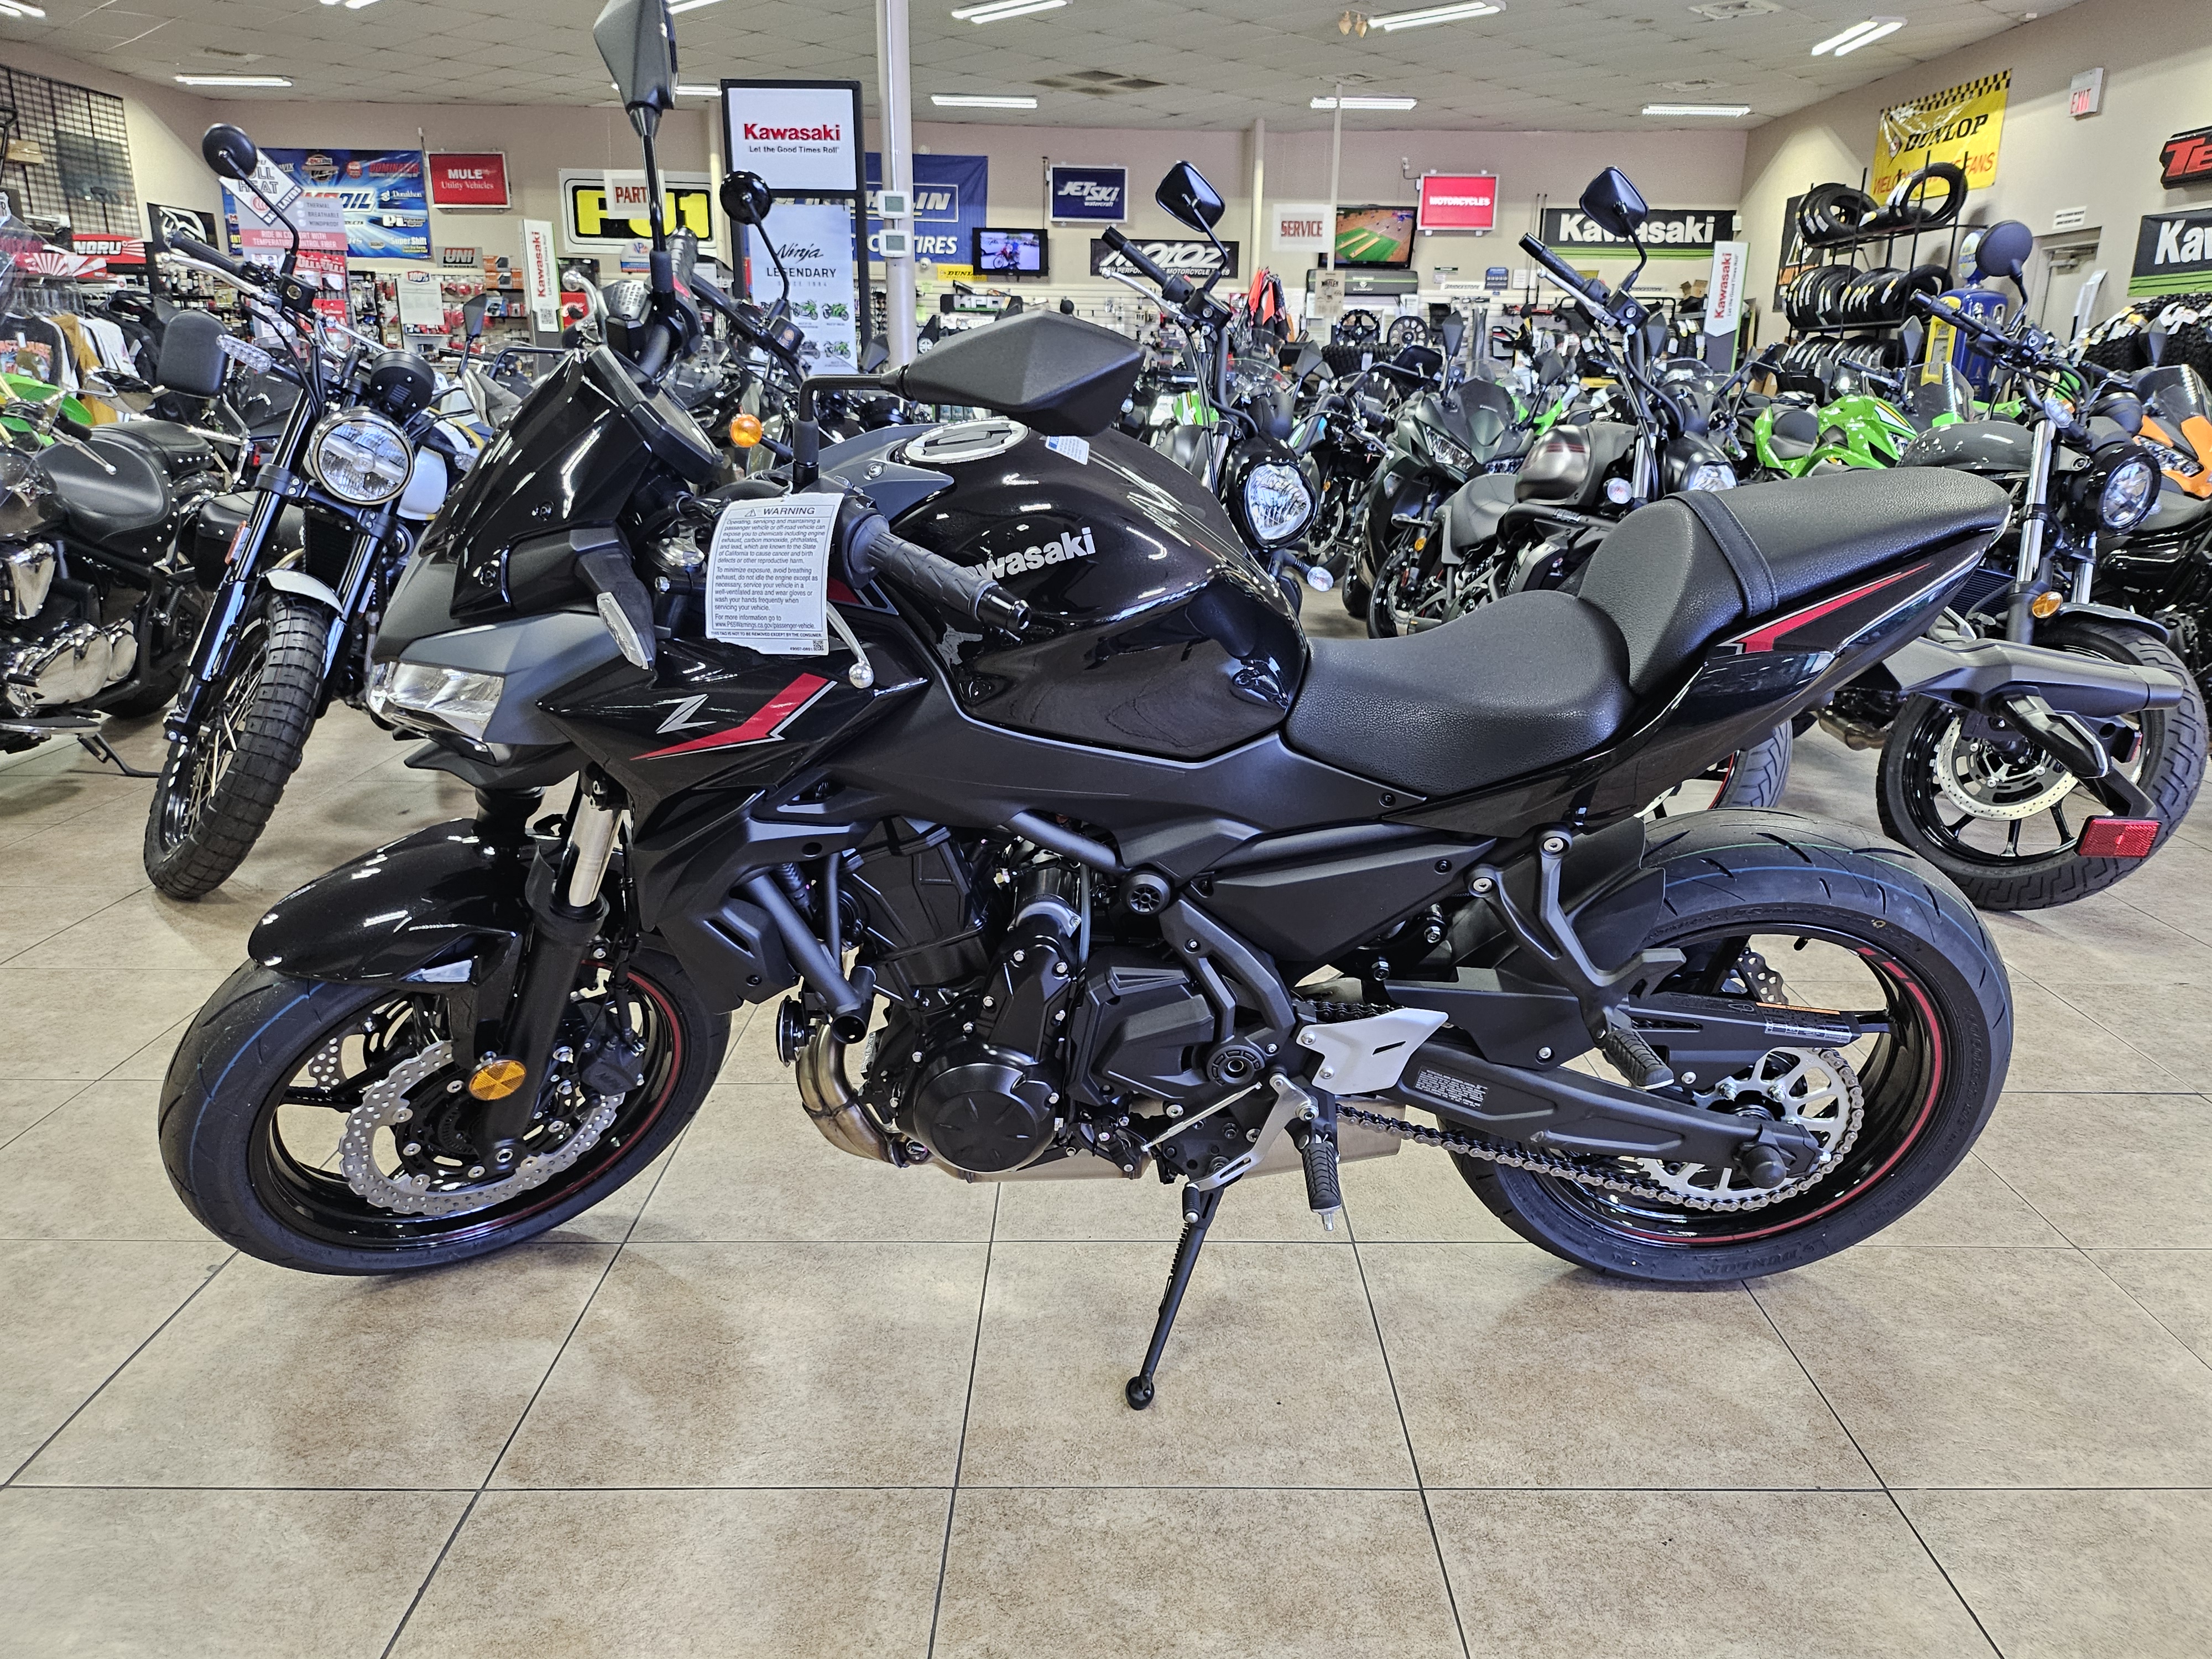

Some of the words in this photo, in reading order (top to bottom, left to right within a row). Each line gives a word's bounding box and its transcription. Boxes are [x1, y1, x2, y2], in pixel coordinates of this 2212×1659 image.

[2070, 88, 2091, 114] EXIT
[744, 123, 841, 140] Kawasaki
[1904, 114, 1989, 152] DUNLOP
[1966, 152, 1995, 175] FANS
[447, 169, 483, 179] MULE
[392, 189, 422, 198] Donaldson
[441, 181, 463, 190] Utility
[465, 181, 494, 189] Vehicles
[1057, 181, 1097, 196] JET
[1085, 187, 1120, 201] SKI
[278, 186, 302, 210] LAYERS
[615, 186, 648, 204] PART
[1430, 196, 1491, 206] MOTORCYCLES
[283, 231, 310, 239] COORT
[1281, 221, 1323, 237] SERVICE
[74, 241, 122, 255] NORU
[411, 236, 427, 245] Shift
[914, 235, 958, 254] TIRES
[2154, 219, 2212, 265] Ka
[445, 248, 474, 263] UNI
[776, 242, 824, 264] Ninja
[531, 231, 546, 298] Kawasaki
[408, 272, 429, 282] 100%
[1714, 252, 1732, 319] Kawasaki
[964, 526, 1096, 580] wasaki
[656, 693, 717, 734] Z
